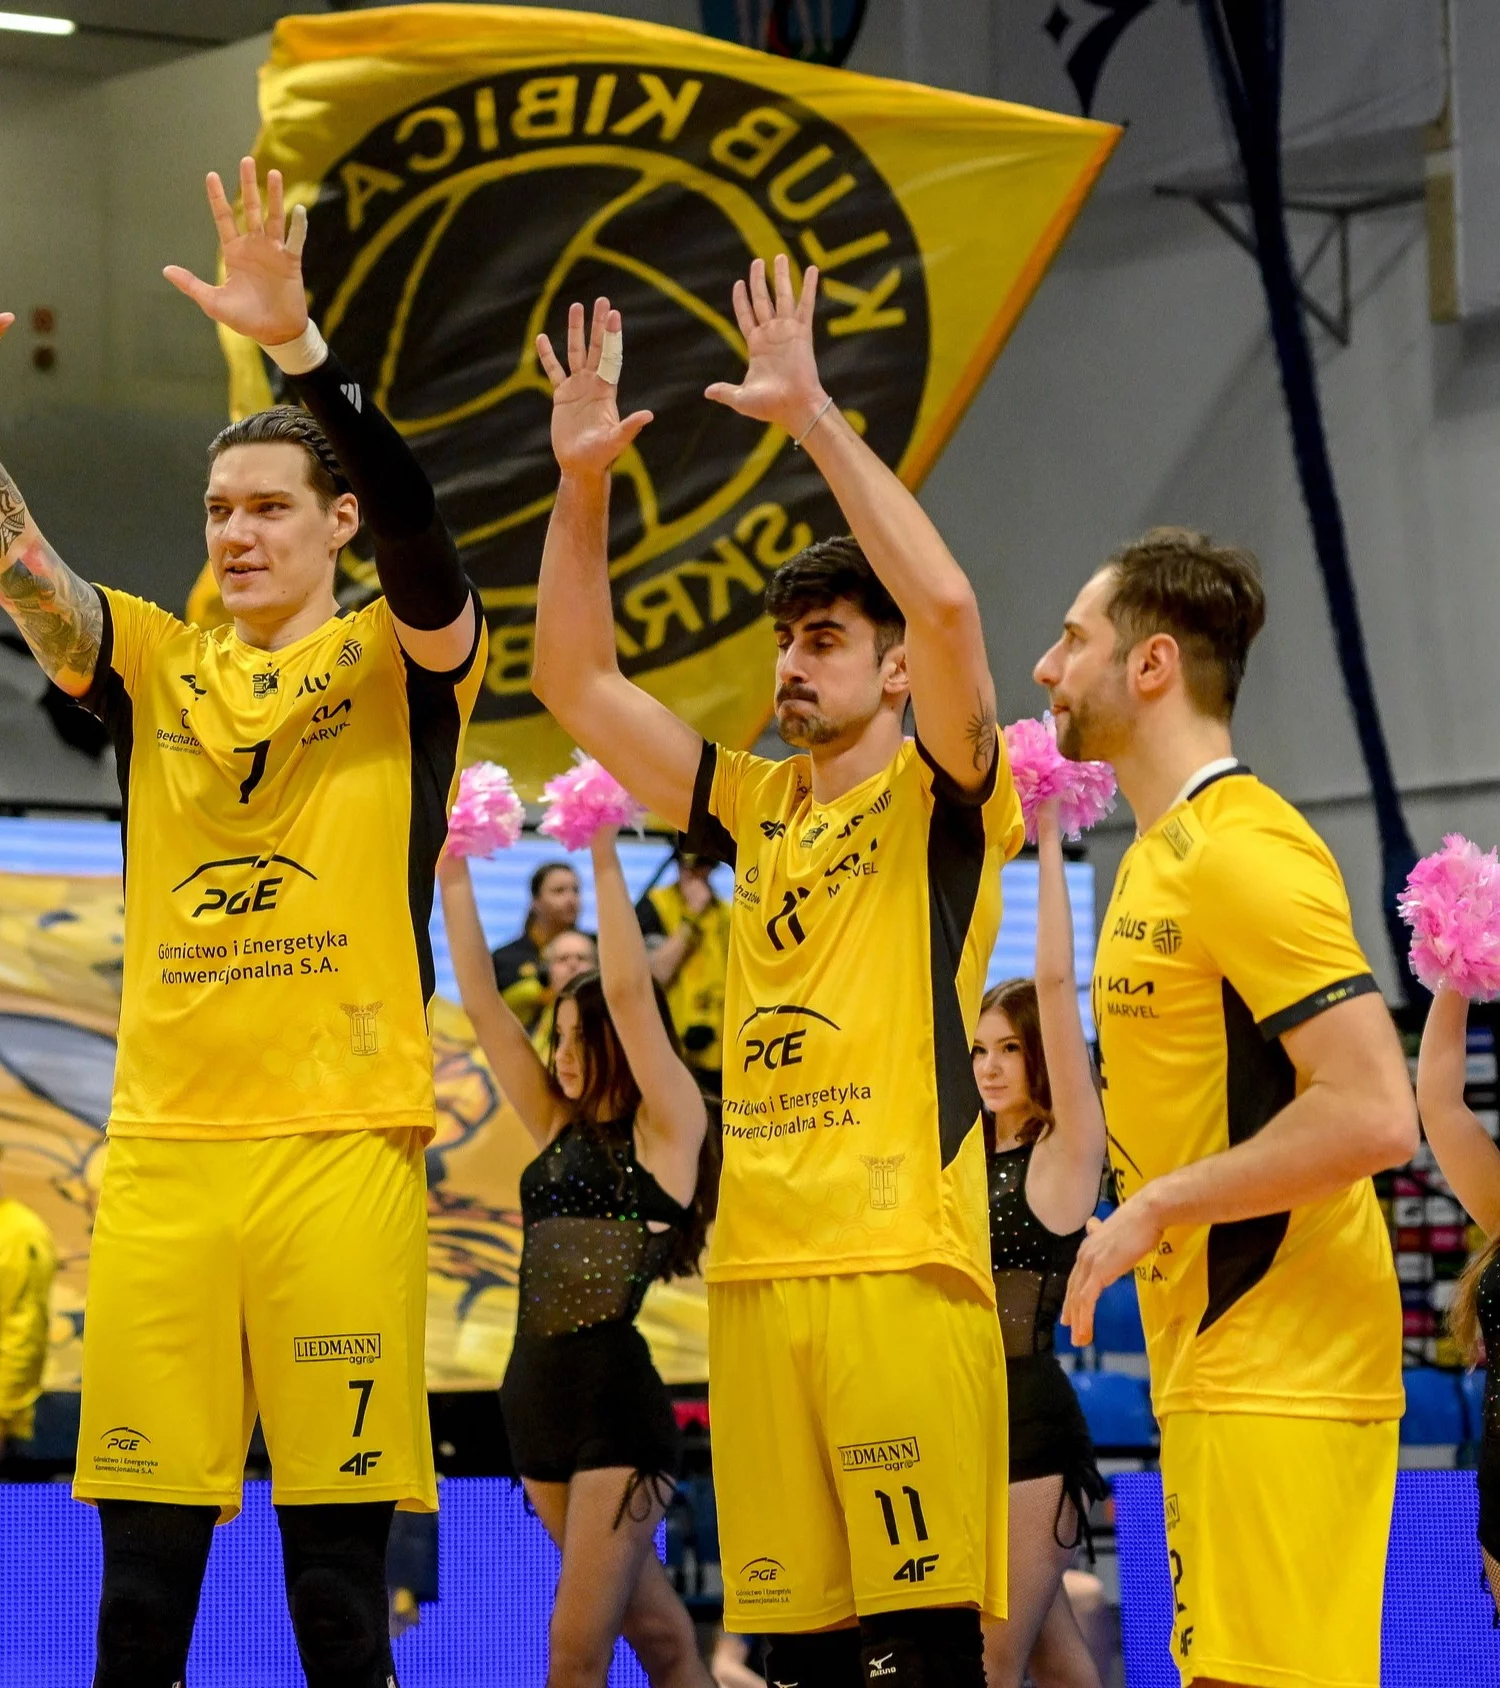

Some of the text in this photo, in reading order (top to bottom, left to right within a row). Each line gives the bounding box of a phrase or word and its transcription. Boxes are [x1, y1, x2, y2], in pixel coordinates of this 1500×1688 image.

[191, 877, 283, 918] PGE
[1111, 911, 1147, 942] plus
[158, 931, 348, 960] Górnictwo i Energetyka
[162, 956, 339, 985] Konwencjonalna S.A.
[1108, 976, 1154, 995] KIA
[1108, 1002, 1160, 1019] MARVEL
[769, 1096, 775, 1113] i
[779, 1082, 871, 1111] Energetyka
[824, 1109, 861, 1127] S.A.
[297, 1338, 377, 1357] LIEDMANN
[349, 1380, 374, 1437] 7
[107, 1438, 140, 1451] PGE
[124, 1458, 159, 1467] Energetyka
[339, 1451, 383, 1476] 4F
[875, 1485, 929, 1546] 11
[749, 1569, 777, 1582] PGE
[893, 1554, 940, 1583] 4F
